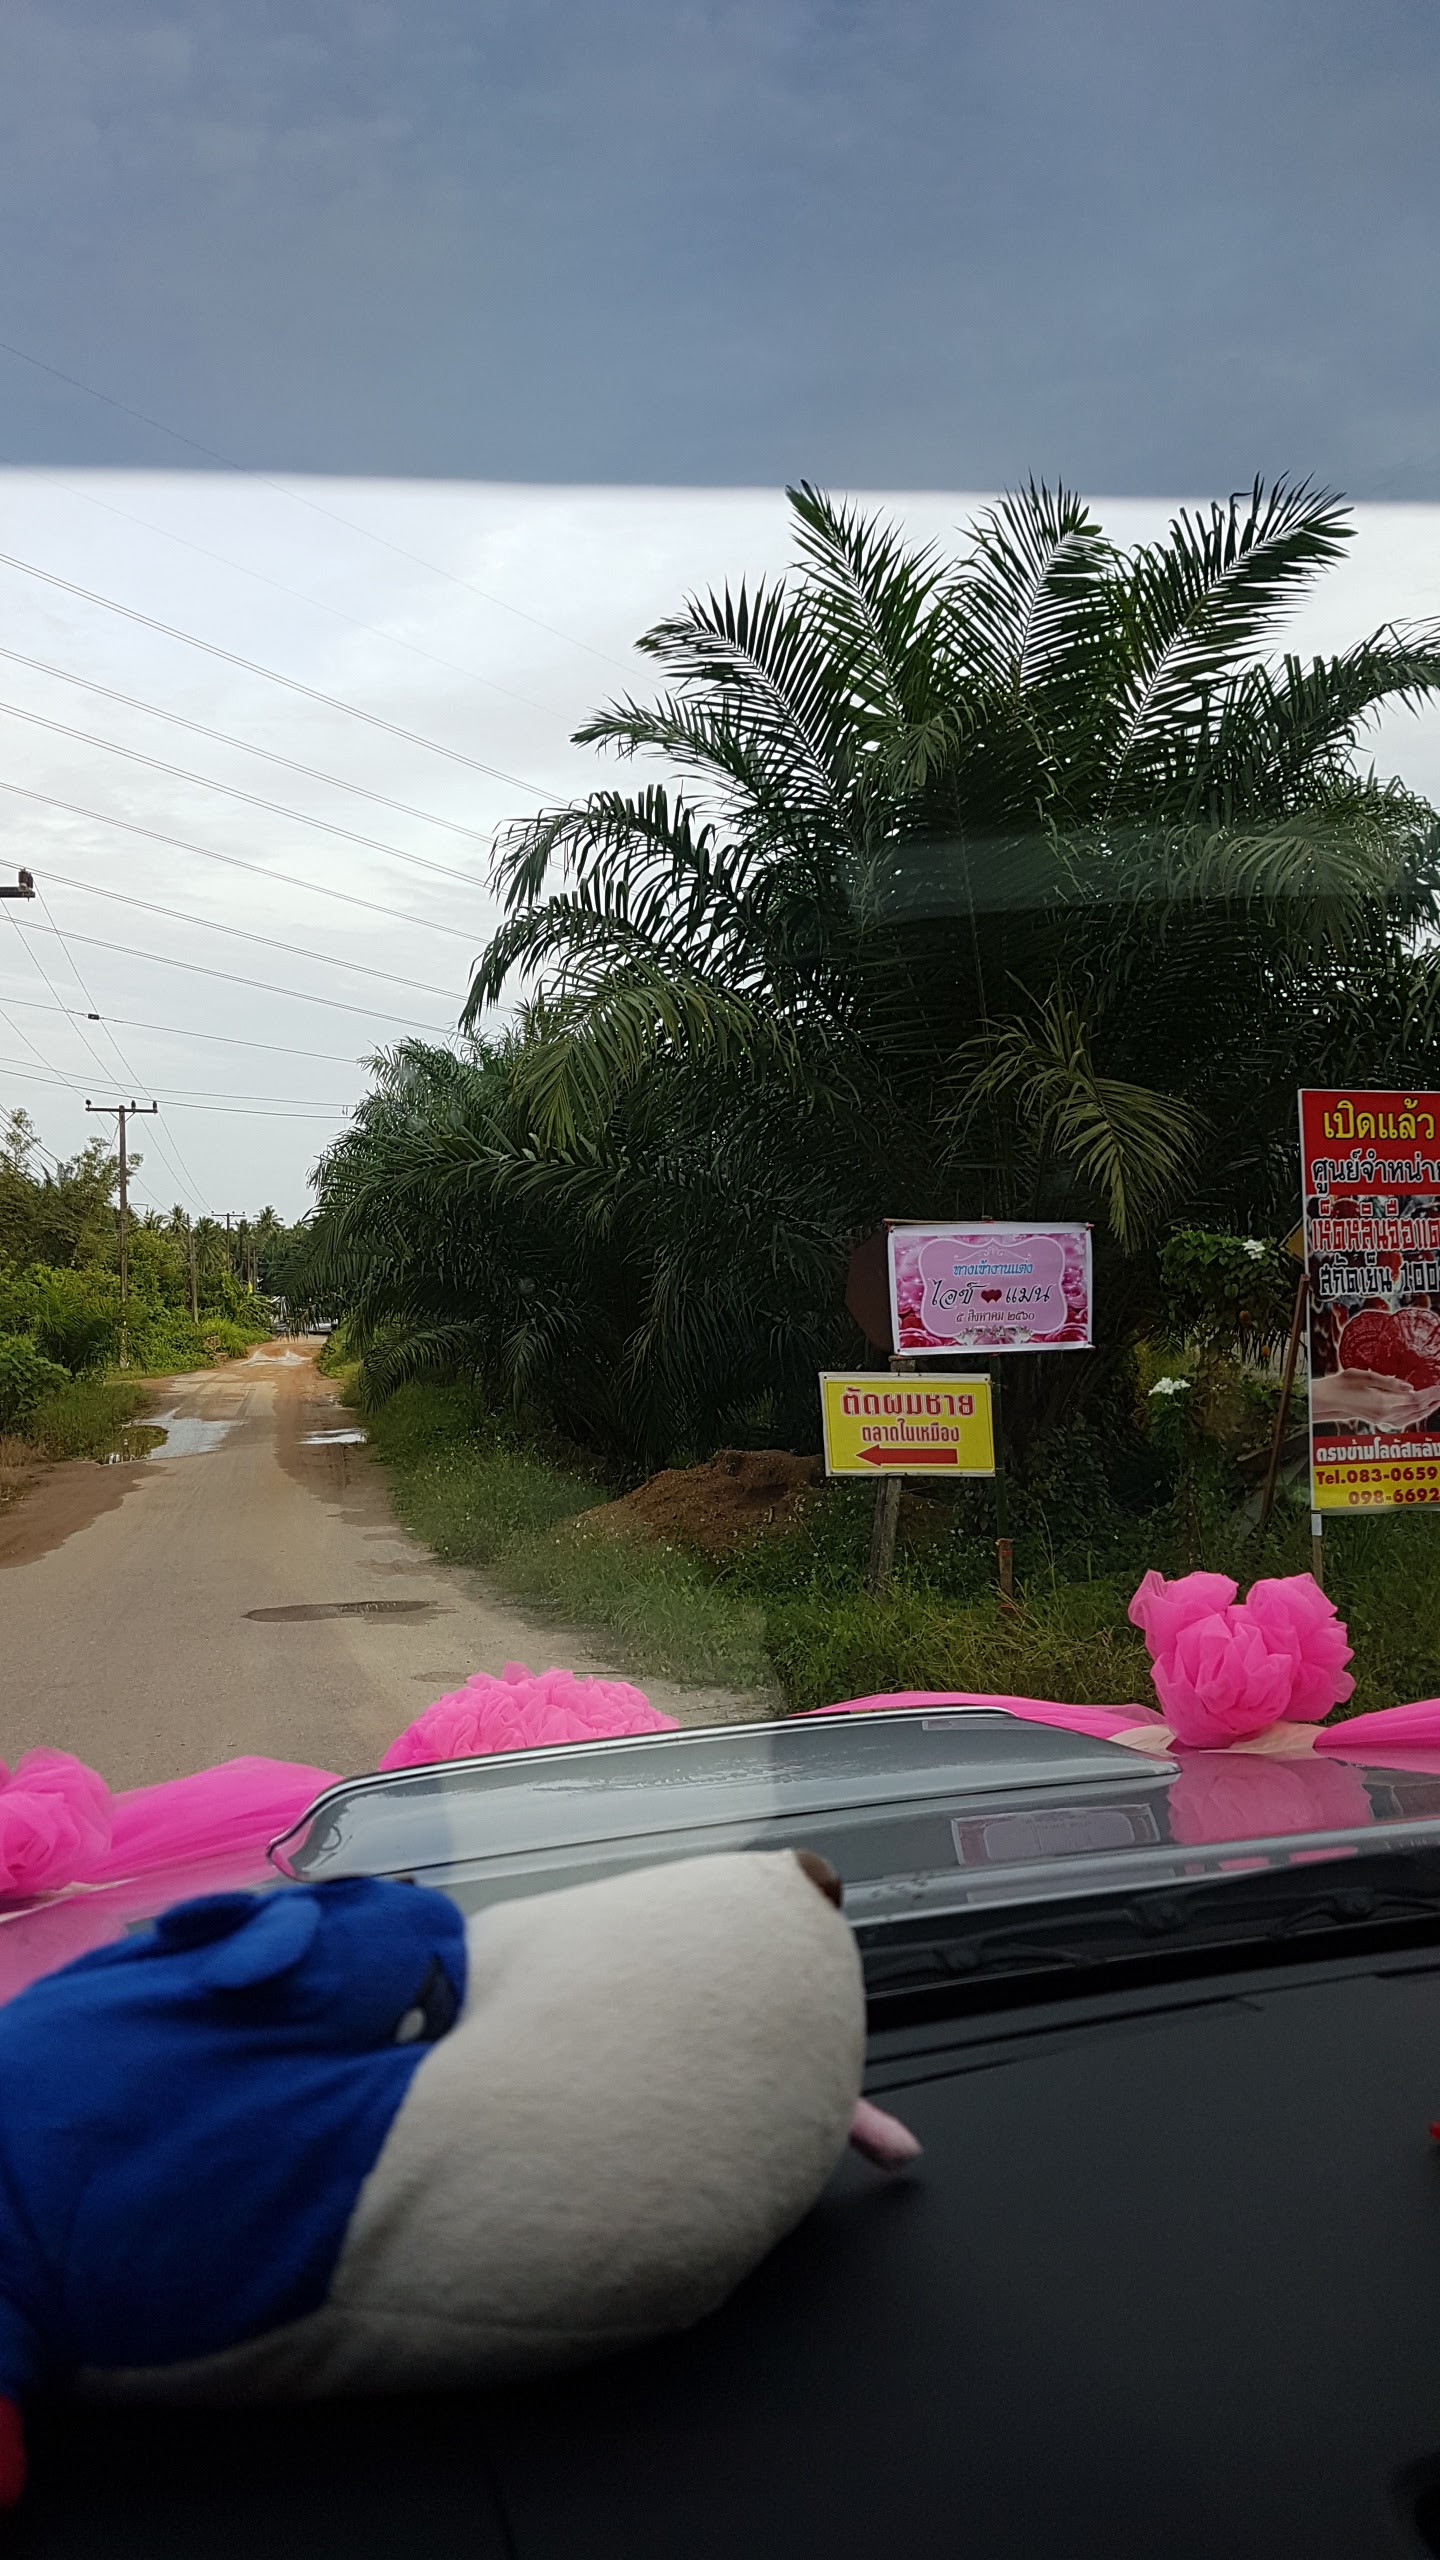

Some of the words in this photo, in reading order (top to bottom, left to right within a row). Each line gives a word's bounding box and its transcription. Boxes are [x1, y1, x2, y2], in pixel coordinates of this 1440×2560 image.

[1323, 1098, 1435, 1139] เปิดแล้ว
[1312, 1148, 1440, 1193] ศูนย์จำหน่า
[953, 1260, 1033, 1276] ทางเข้างานแต่ง
[1005, 1284, 1055, 1304] แมน
[967, 1309, 1003, 1321] สิงหาคม
[842, 1387, 975, 1416] ตัดผมชาย
[861, 1418, 961, 1443] ตลาดในเหมือง
